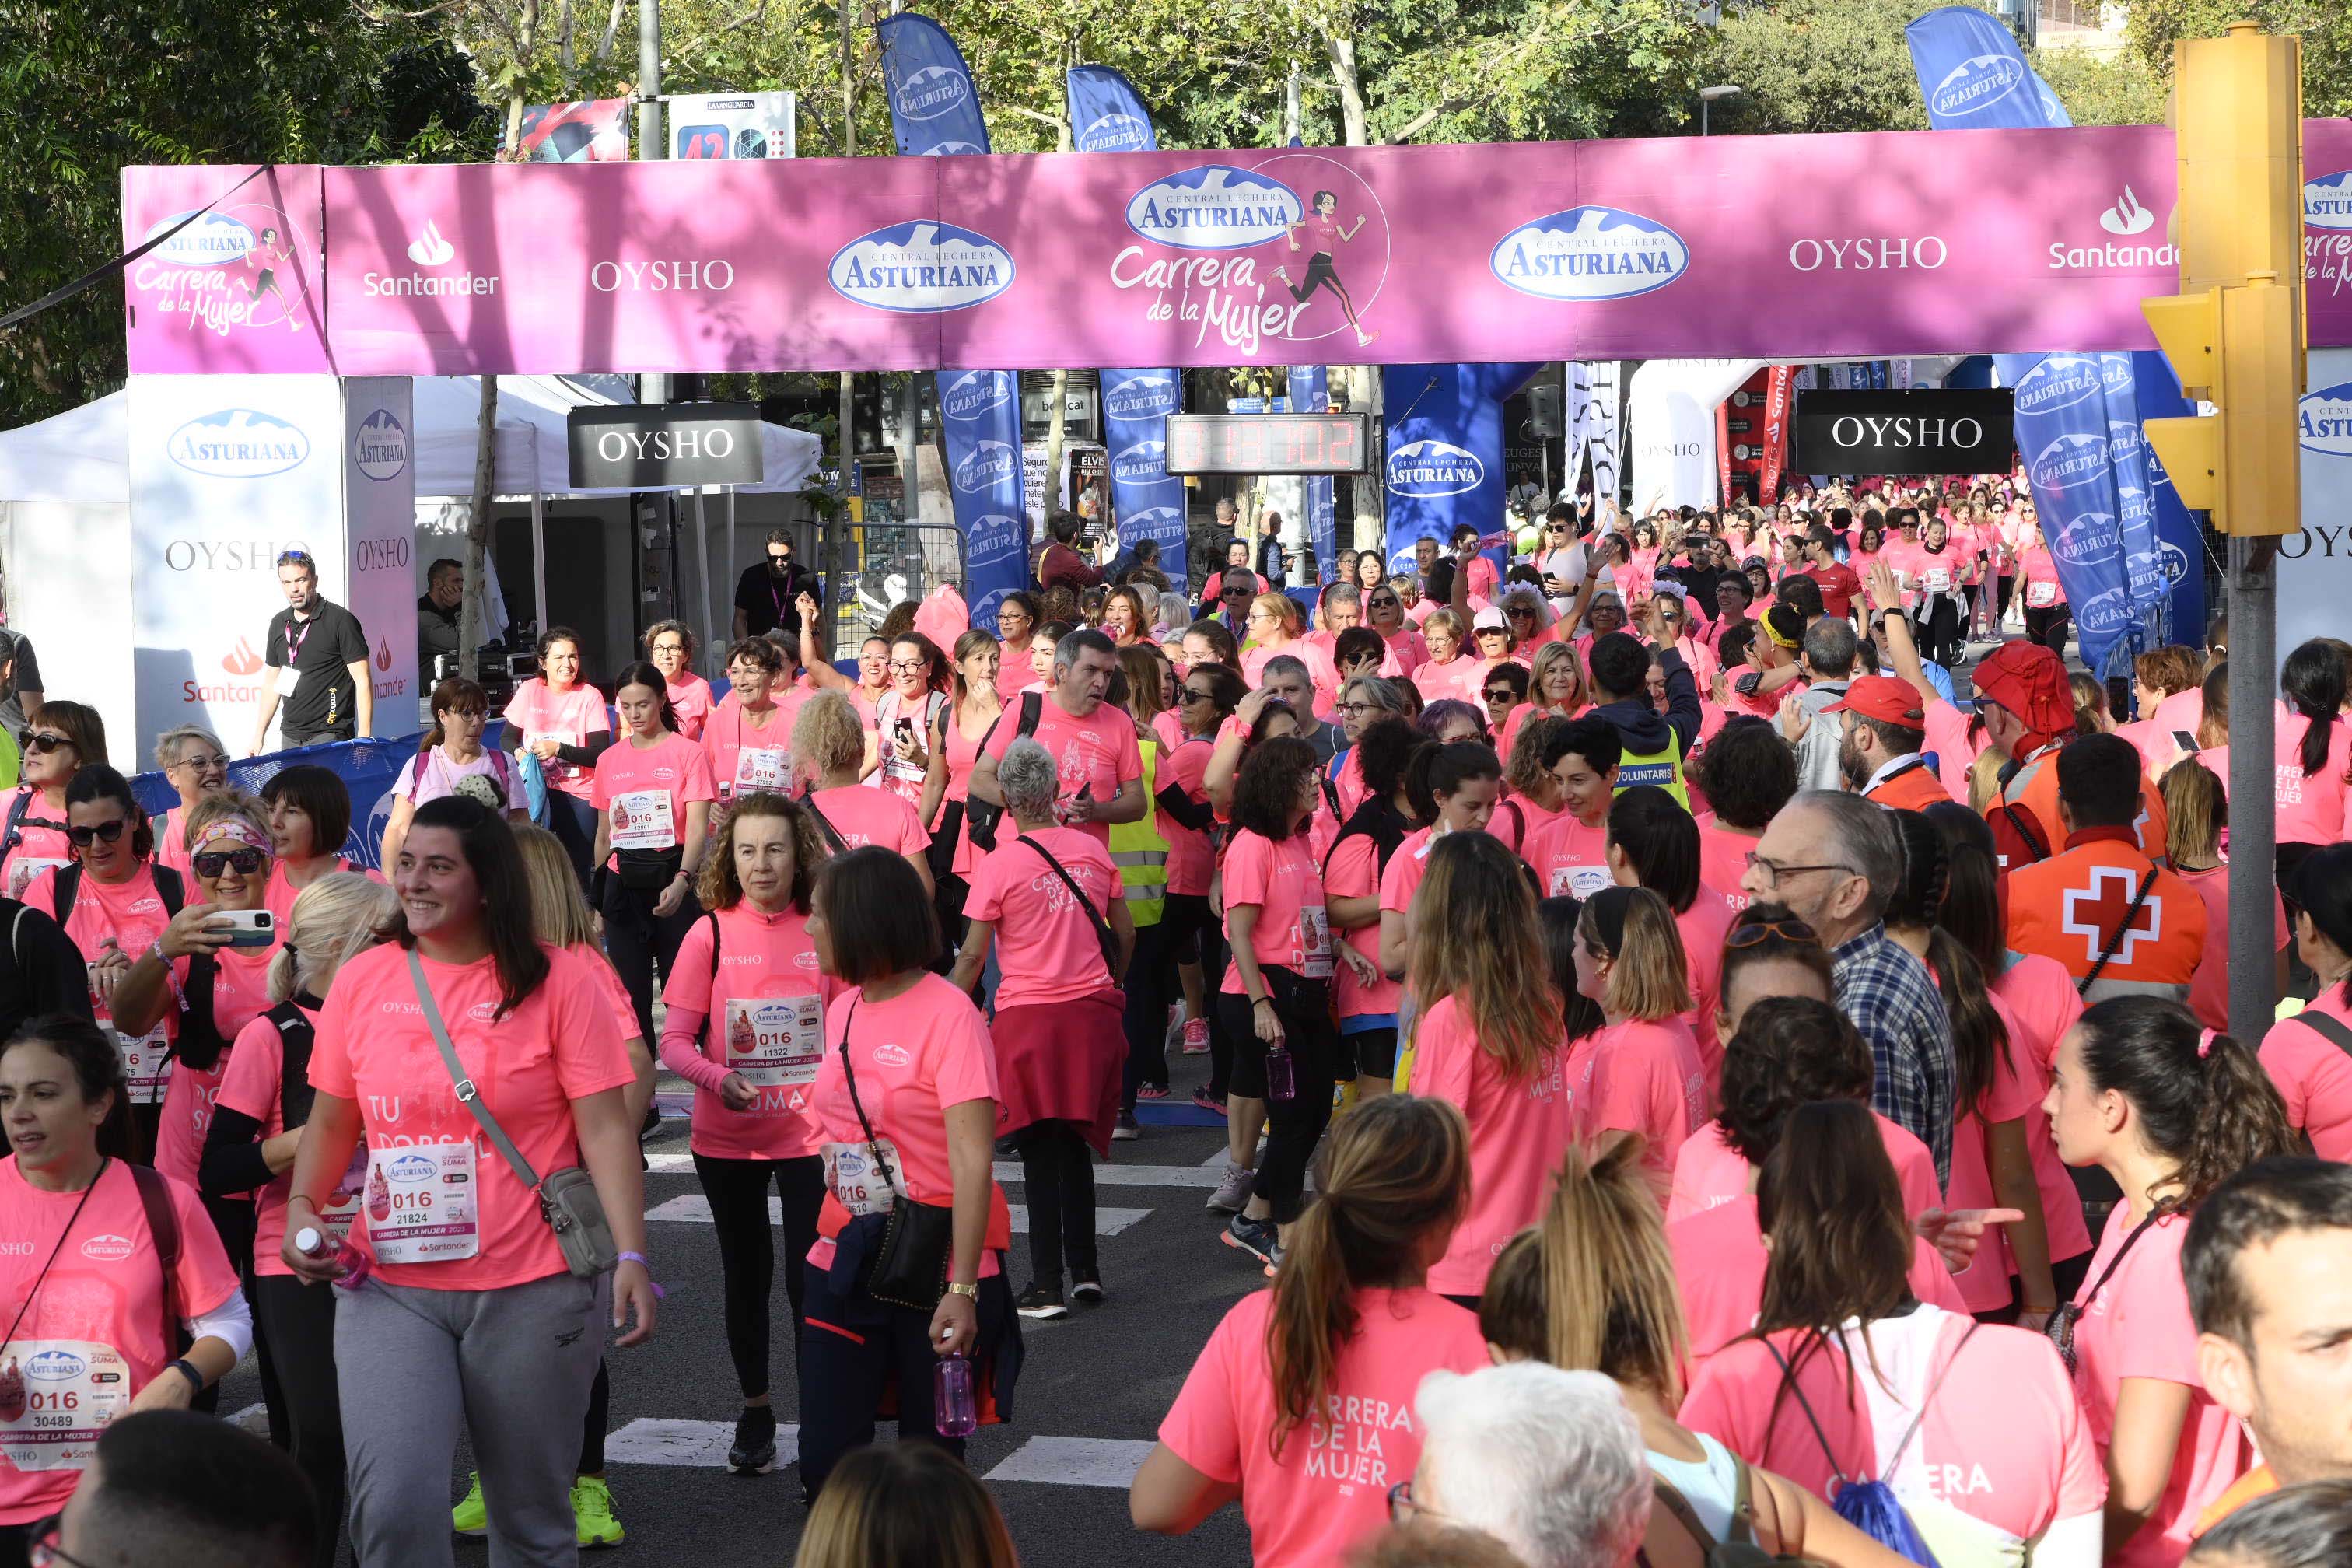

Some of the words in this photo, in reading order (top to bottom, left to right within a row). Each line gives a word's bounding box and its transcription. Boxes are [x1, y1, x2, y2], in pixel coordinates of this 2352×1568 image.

[1167, 194, 1223, 203] CENTRAL
[1227, 193, 1284, 202] LECHERA
[1139, 197, 1289, 229] ASTURIANA
[1537, 238, 1597, 249] CENTRAL
[1605, 237, 1666, 247] LECHERA
[871, 252, 929, 261] CENTRAL
[936, 251, 995, 260] LECHERA
[1506, 243, 1673, 277] ASTURIANA
[1789, 236, 1947, 271] OYSHO
[2049, 241, 2180, 269] Santand
[842, 255, 1001, 288] ASTURIANA
[1111, 245, 1257, 289] Carrera
[135, 262, 227, 291] Carrera
[591, 260, 734, 292] OYSHO
[363, 271, 499, 296] Santander
[158, 293, 175, 313] de
[179, 292, 191, 312] la
[189, 287, 261, 337] Mujer
[1146, 291, 1174, 321] de
[1180, 291, 1199, 321] la
[1195, 283, 1311, 357] Mujer
[1042, 400, 1084, 412] b.cat
[1832, 416, 1982, 449] OYSHO
[180, 435, 299, 460] ASTURIANA
[598, 429, 733, 462] OYSHO
[359, 445, 404, 464] ASTURIANA
[1081, 456, 1106, 467] ELVIS
[1024, 470, 1037, 480] que
[1390, 462, 1476, 485] ASTURIANA
[2277, 526, 2352, 559] OY
[356, 537, 408, 572] OYSHO
[756, 770, 775, 779] 016
[2287, 779, 2301, 792] LA
[2276, 790, 2303, 804] UJER
[631, 814, 652, 824] 016
[1552, 854, 1580, 863] OYSHO
[1032, 866, 1093, 891] CARERA
[1047, 882, 1063, 899] DE
[723, 954, 761, 966] OYSHO
[795, 955, 820, 966] ASTURI
[383, 1002, 425, 1016] OYSH
[757, 1013, 793, 1022] ASTURIANA
[759, 1032, 792, 1046] 016
[763, 1048, 788, 1057] 11322
[875, 1049, 910, 1062] ASTURIANA
[742, 1071, 765, 1080] YSHO
[789, 1069, 816, 1077] Santande
[368, 1095, 400, 1122] TU
[442, 1158, 467, 1167] SUMA
[390, 1166, 433, 1178] ASTURIANA
[840, 1185, 866, 1200] 016
[393, 1191, 432, 1209] 016
[397, 1213, 428, 1225] 21824
[377, 1230, 399, 1239] CARRERA
[421, 1227, 446, 1235] MUJER
[85, 1244, 131, 1255] ASTURIANA
[429, 1241, 469, 1251] Santander
[91, 1355, 118, 1365] SUMA
[29, 1363, 81, 1374] ASTURIANA
[30, 1391, 79, 1410] 016
[1304, 1394, 1412, 1433] ARRERA
[33, 1416, 73, 1428] 30489
[37, 1432, 48, 1440] DE
[49, 1432, 63, 1440] LA
[64, 1431, 93, 1440] MUJER
[1309, 1423, 1345, 1451] DE
[1356, 1427, 1384, 1458] LA
[1304, 1451, 1388, 1488] MUJER
